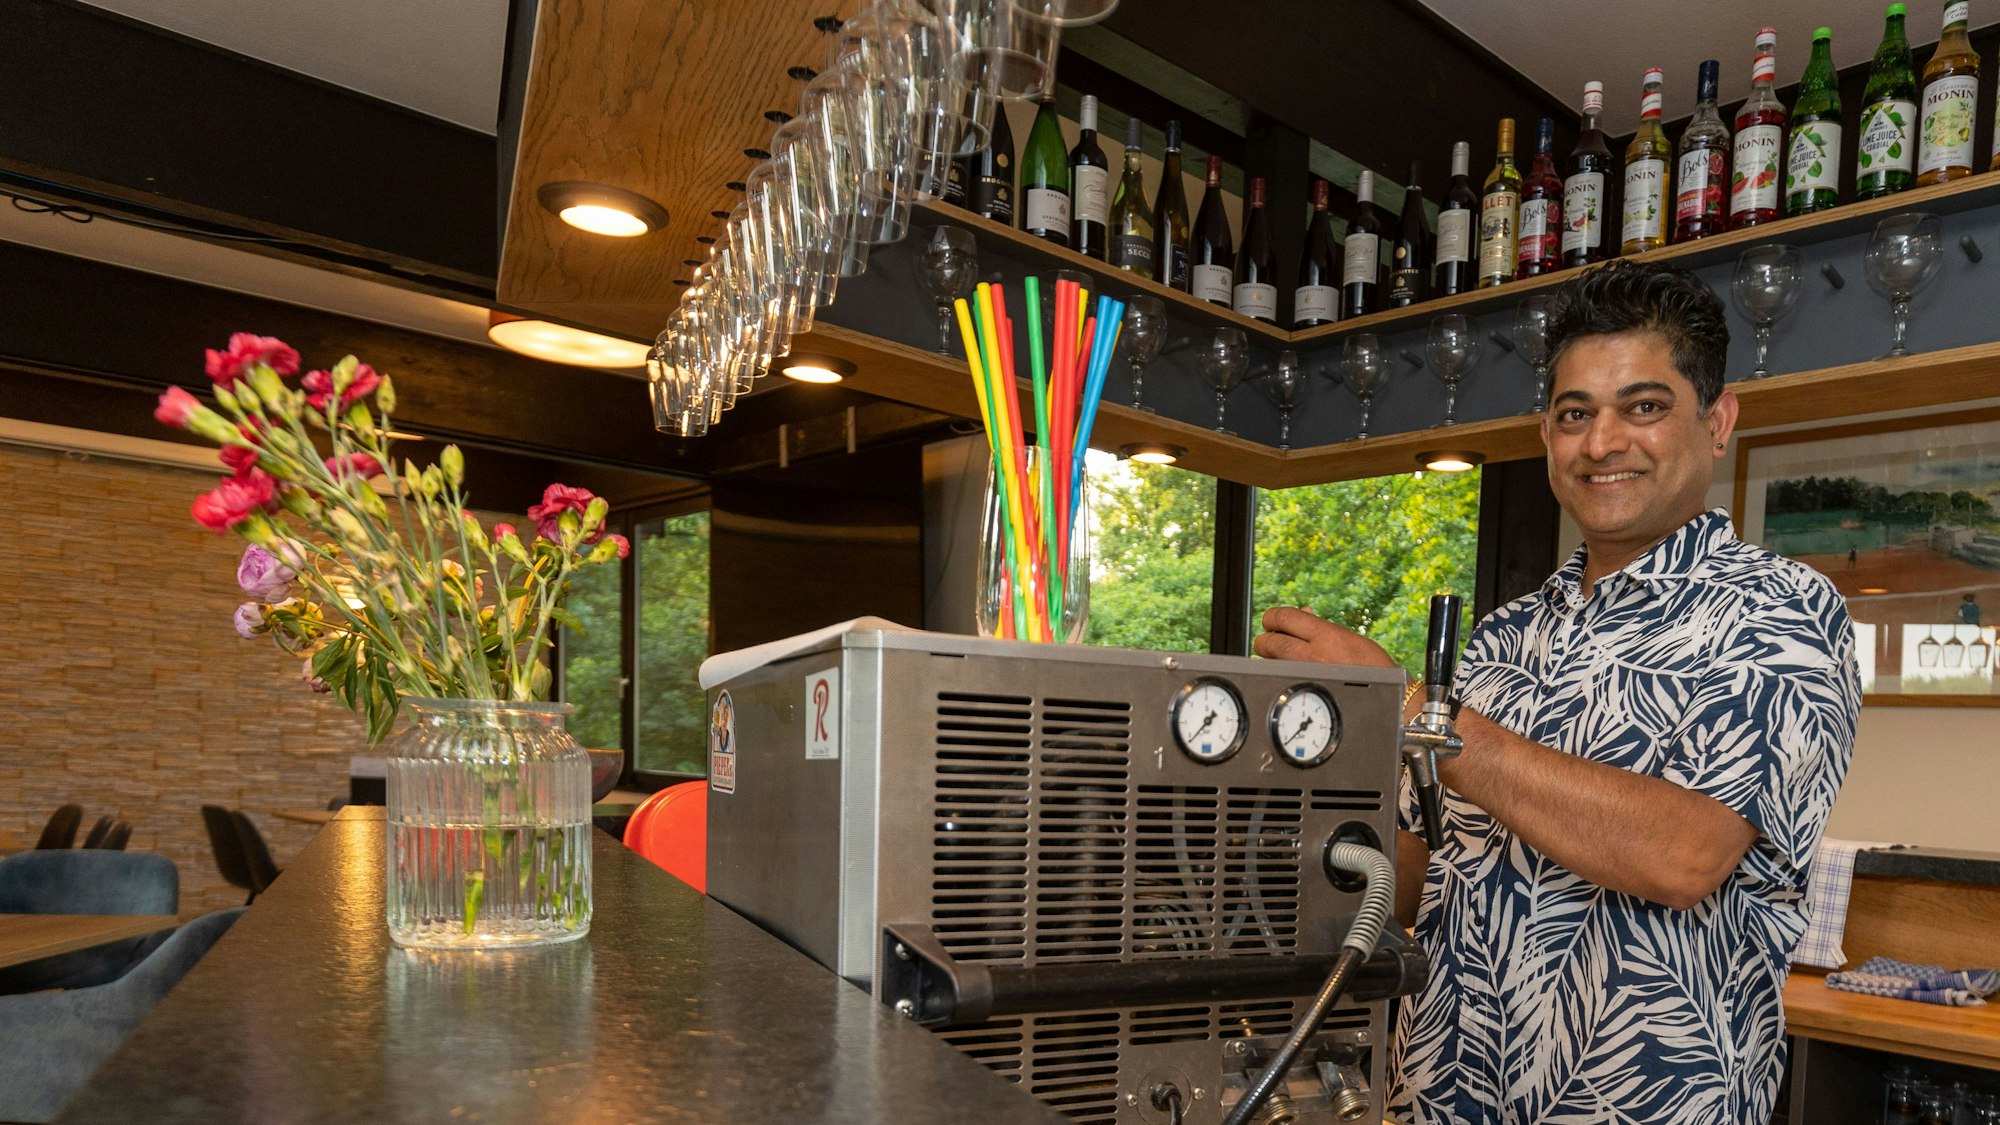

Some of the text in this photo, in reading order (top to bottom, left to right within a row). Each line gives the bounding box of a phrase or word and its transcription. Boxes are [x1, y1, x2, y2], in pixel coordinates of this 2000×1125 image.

[1928, 89, 1975, 107] MONIN
[1876, 130, 1898, 142] JUICE
[1866, 141, 1890, 152] CORDIAL
[1798, 150, 1818, 163] JUICE
[1626, 170, 1656, 184] ONIN
[1680, 152, 1708, 186] Bols
[1485, 196, 1512, 210] LLET
[1520, 200, 1547, 233] Bols
[1128, 248, 1151, 260] SECCO
[813, 678, 829, 742] R
[1154, 746, 1164, 771] 1
[1260, 751, 1274, 773] 2
